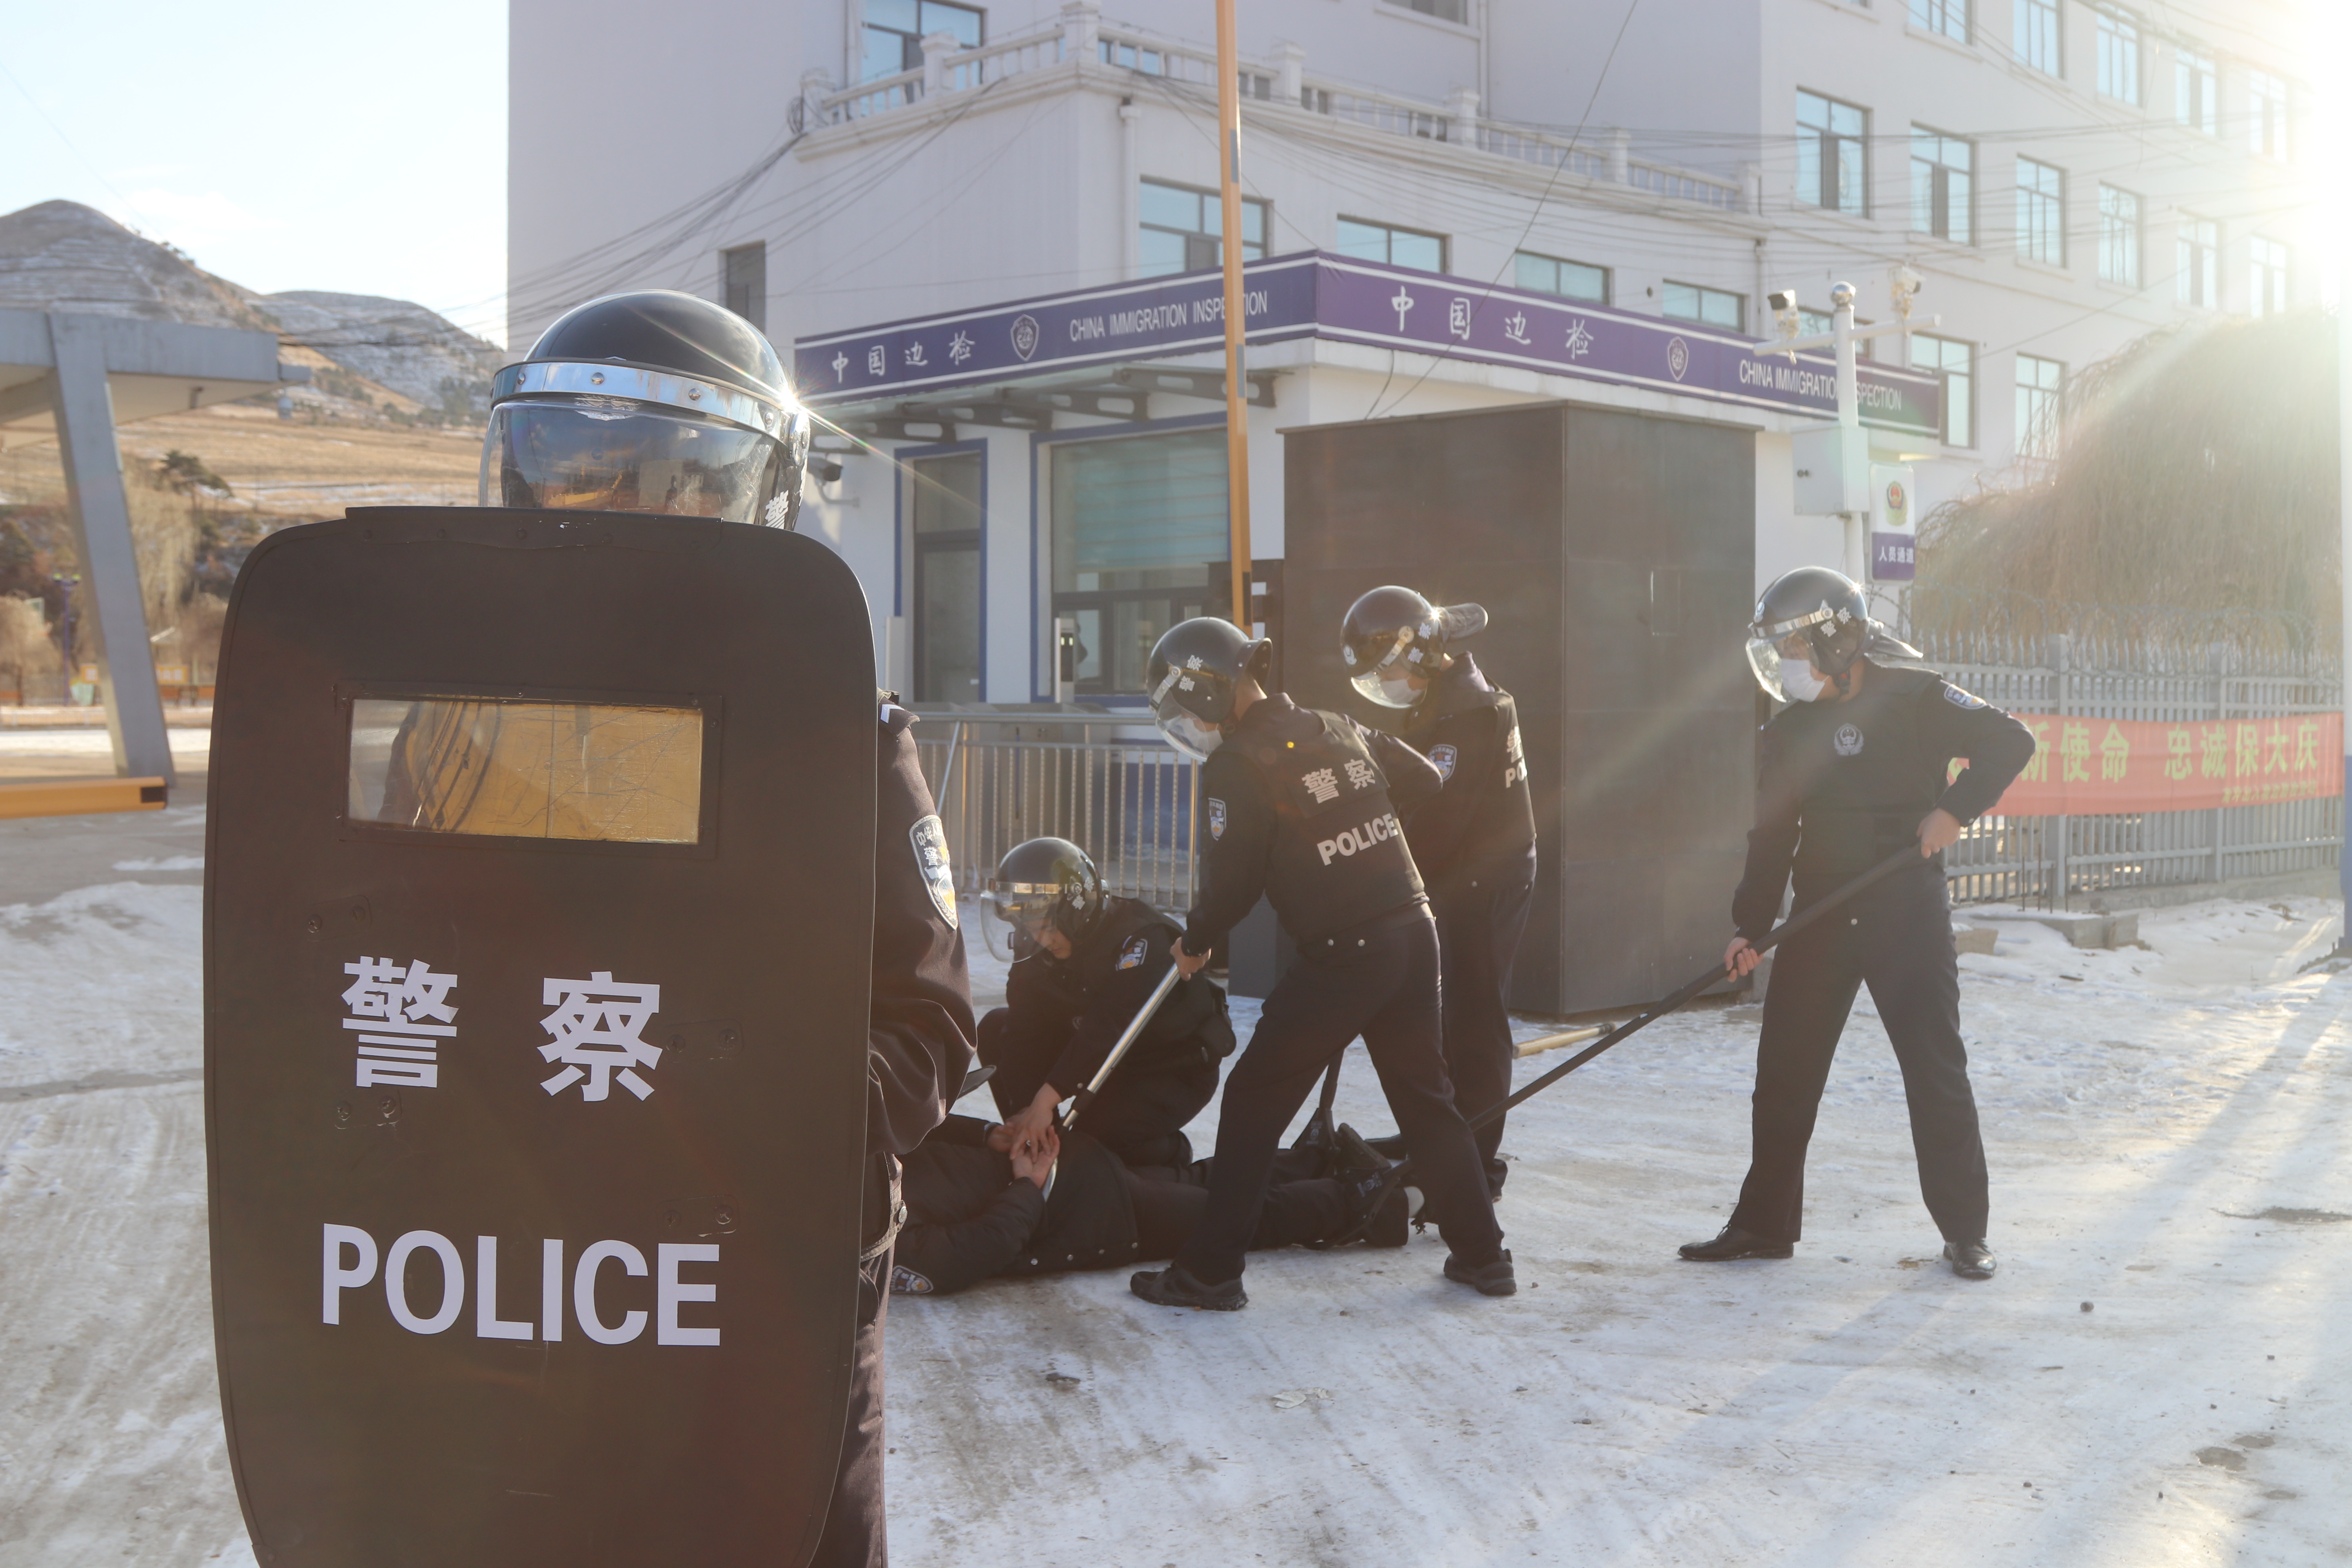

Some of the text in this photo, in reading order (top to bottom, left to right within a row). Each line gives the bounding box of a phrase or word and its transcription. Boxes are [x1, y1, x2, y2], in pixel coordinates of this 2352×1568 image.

[1069, 290, 1268, 342] CHINA IMMIGRATION INSPEION
[1391, 285, 1594, 361] 中国边检
[831, 330, 976, 384] 中国边检
[1739, 359, 1902, 412] CHINA IMMIGRATIO SPECTION
[1878, 546, 1914, 564] 人员通道
[2164, 719, 2318, 780] 忠诚保大庆
[1301, 759, 1376, 804] 警察
[1317, 813, 1399, 866] POLICE
[341, 955, 663, 1102] 警察
[323, 1223, 720, 1346] POLICE
